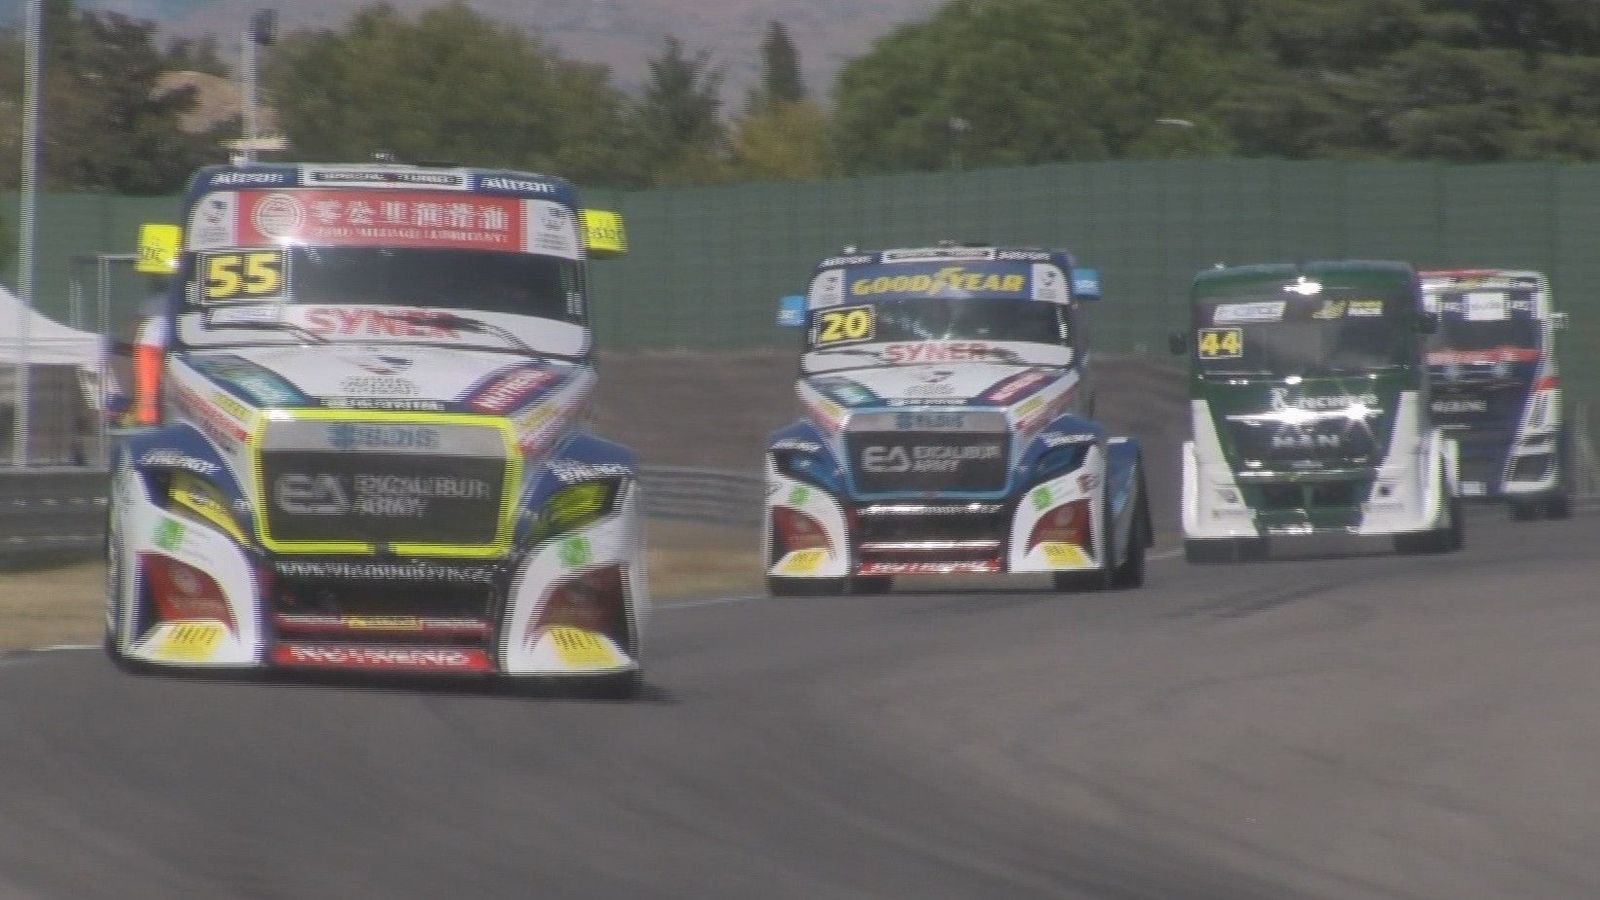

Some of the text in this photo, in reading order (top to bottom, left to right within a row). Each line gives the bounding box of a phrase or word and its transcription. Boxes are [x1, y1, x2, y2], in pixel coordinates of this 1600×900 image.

[480, 176, 556, 194] Altron
[203, 254, 282, 299] 55
[304, 306, 463, 339] SYNER
[819, 311, 871, 341] 20
[1199, 330, 1239, 356] 44
[912, 458, 960, 474] ARMY
[352, 474, 491, 500] EXCALIBUR
[351, 497, 430, 519] ARMY
